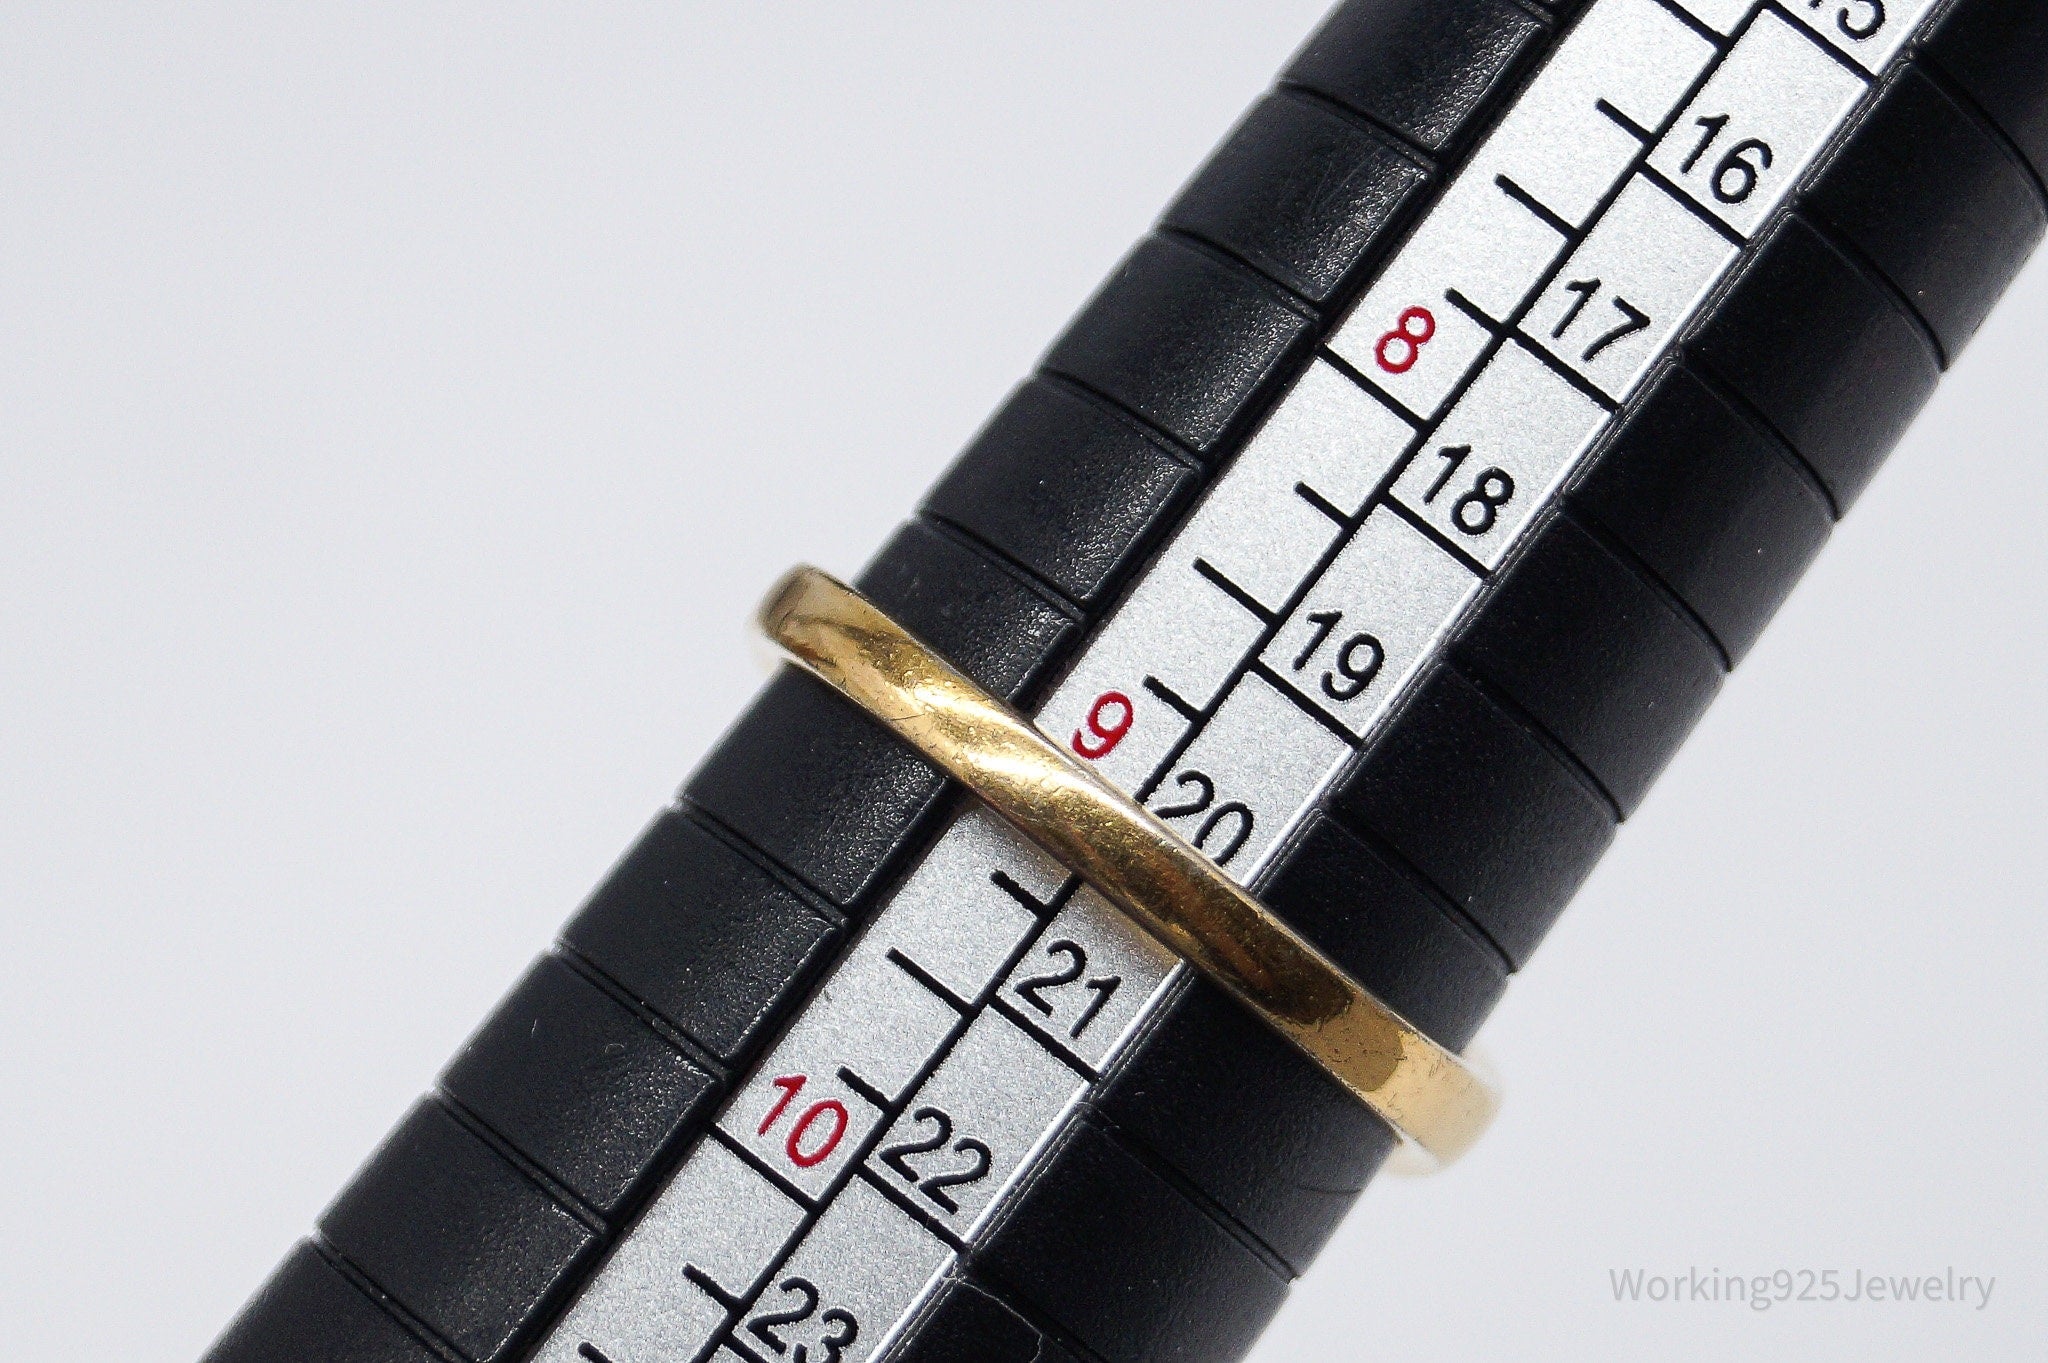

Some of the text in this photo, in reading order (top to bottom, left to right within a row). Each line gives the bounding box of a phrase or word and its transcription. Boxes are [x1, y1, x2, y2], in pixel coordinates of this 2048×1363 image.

[1680, 113, 1774, 205] 16
[1376, 306, 1436, 374] 8
[1552, 277, 1651, 363] 17
[1424, 445, 1516, 537] 18
[1292, 610, 1386, 703] 19
[1072, 691, 1134, 760] 9
[1153, 769, 1255, 869] 20
[1013, 939, 1122, 1040] 21
[757, 1075, 849, 1169] 10
[878, 1105, 994, 1216] 22
[745, 1276, 860, 1363] 23
